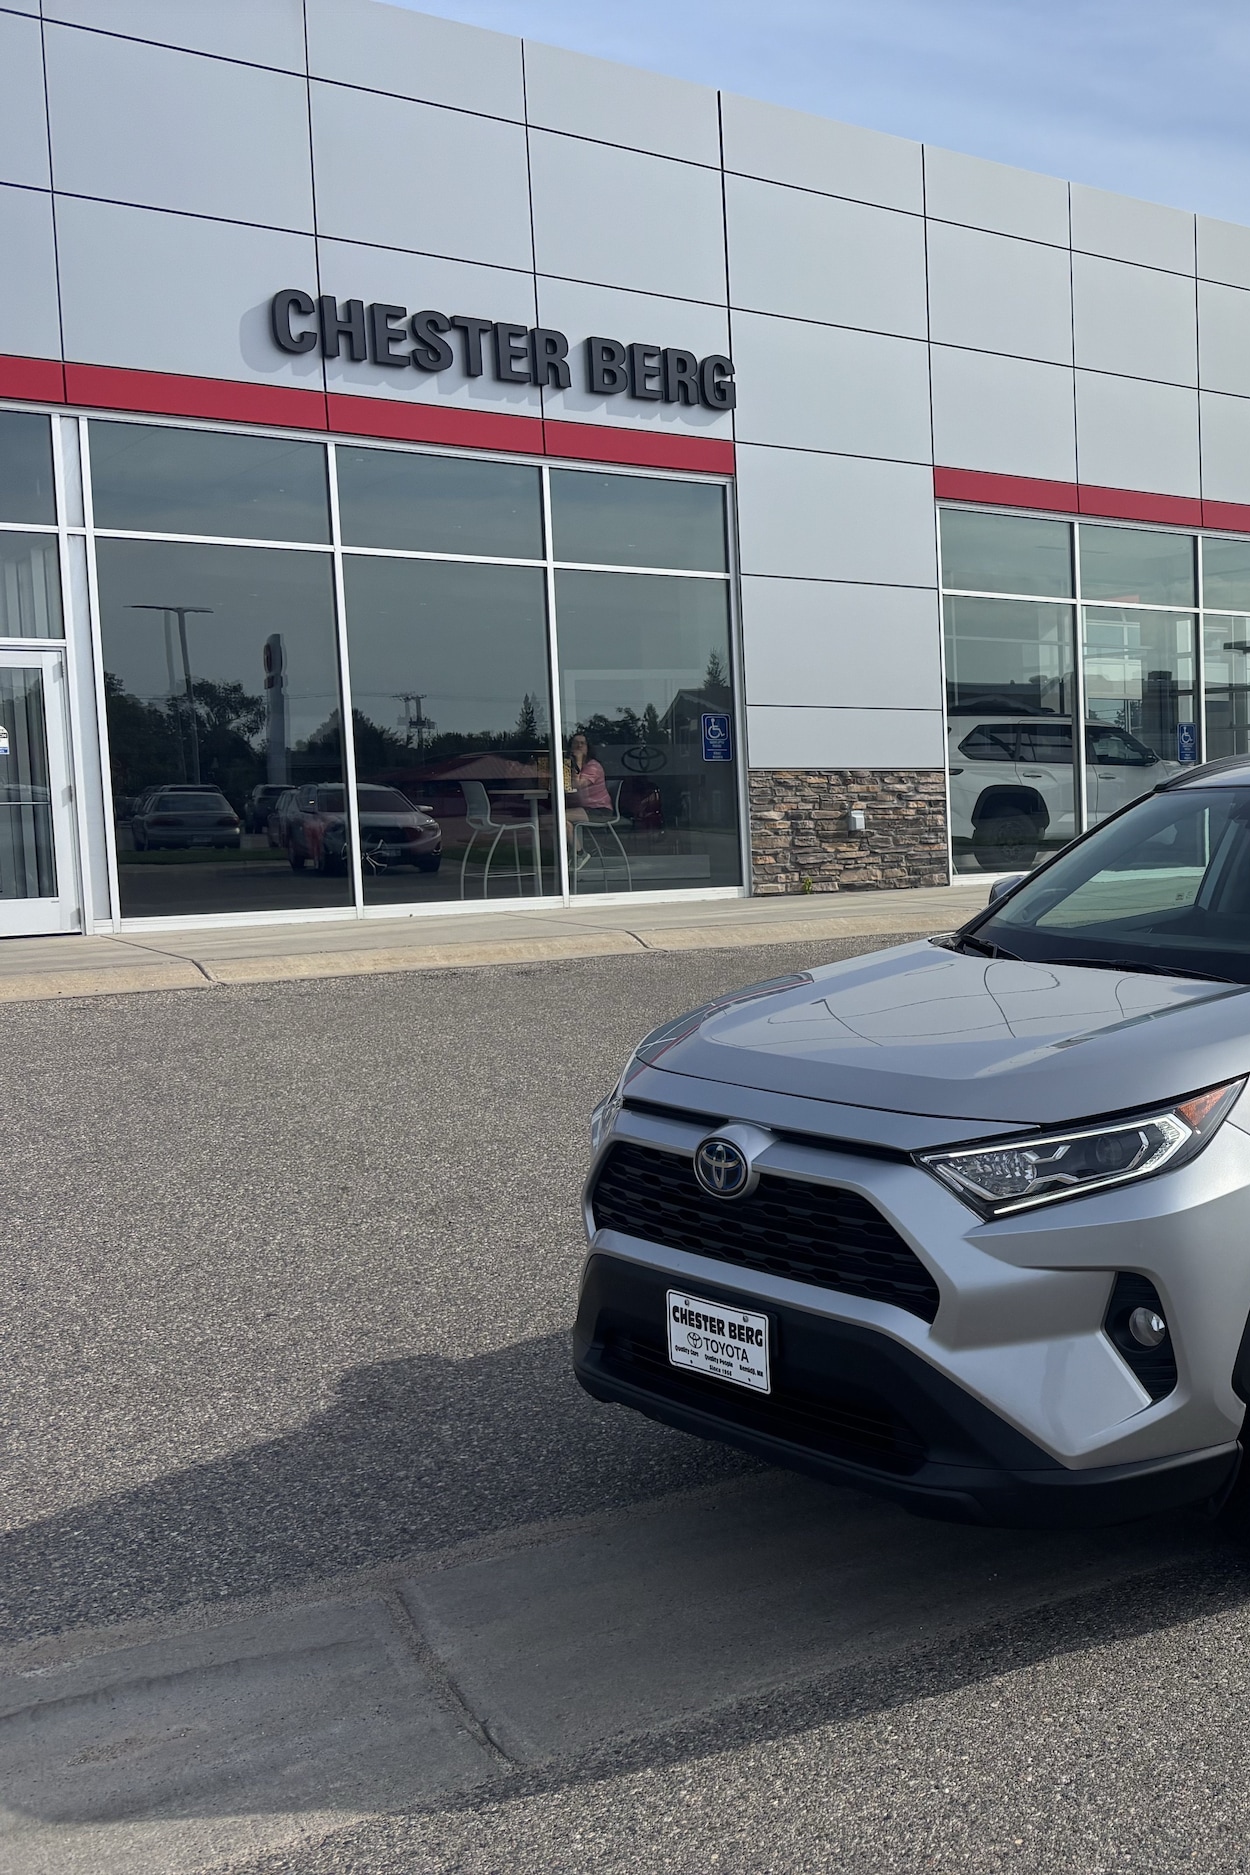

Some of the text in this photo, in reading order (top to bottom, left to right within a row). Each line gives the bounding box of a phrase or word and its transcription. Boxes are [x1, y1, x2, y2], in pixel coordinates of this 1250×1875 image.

[271, 288, 737, 410] CHESTER BERG
[672, 1306, 763, 1347] CHESTER BERG
[674, 1344, 690, 1355] Quality
[703, 1337, 749, 1363] TOYOTA
[704, 1353, 733, 1368] Quality People
[709, 1364, 721, 1373] Since
